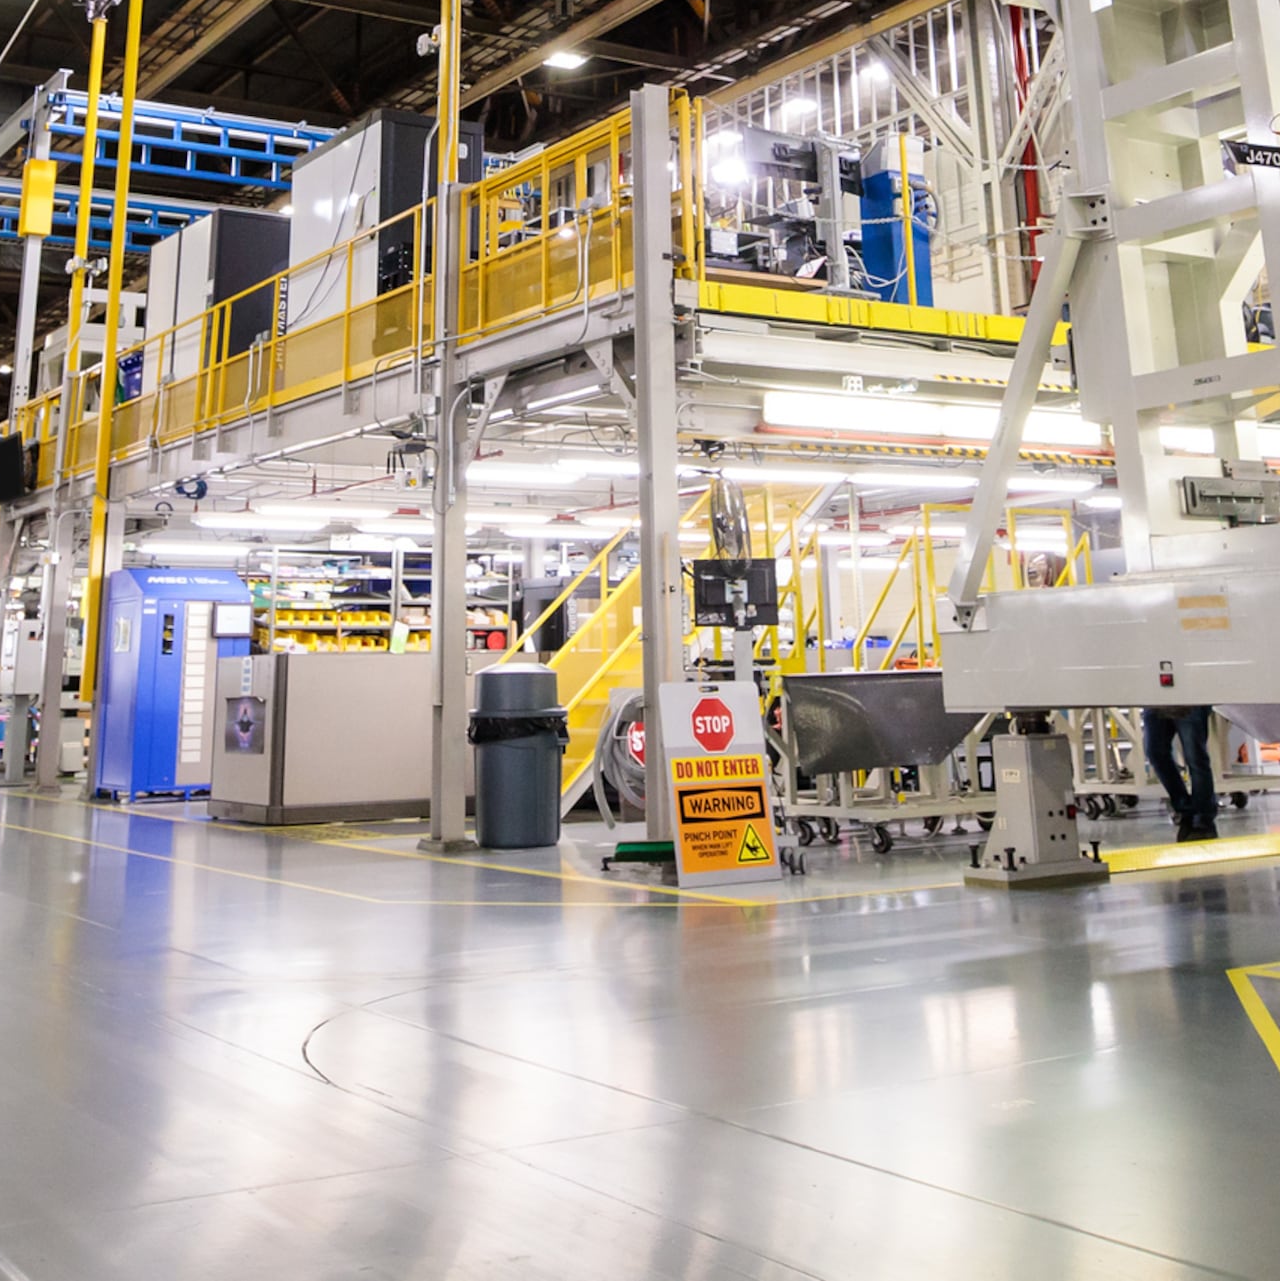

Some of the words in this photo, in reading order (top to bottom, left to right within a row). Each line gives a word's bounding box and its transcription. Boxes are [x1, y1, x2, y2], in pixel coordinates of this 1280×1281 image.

[695, 715, 730, 734] STOP
[675, 761, 693, 779] DO
[696, 759, 720, 777] NOT
[723, 758, 760, 776] ENTER
[689, 795, 755, 814] WARNING
[684, 831, 710, 842] PINCH
[712, 829, 738, 840] POINT
